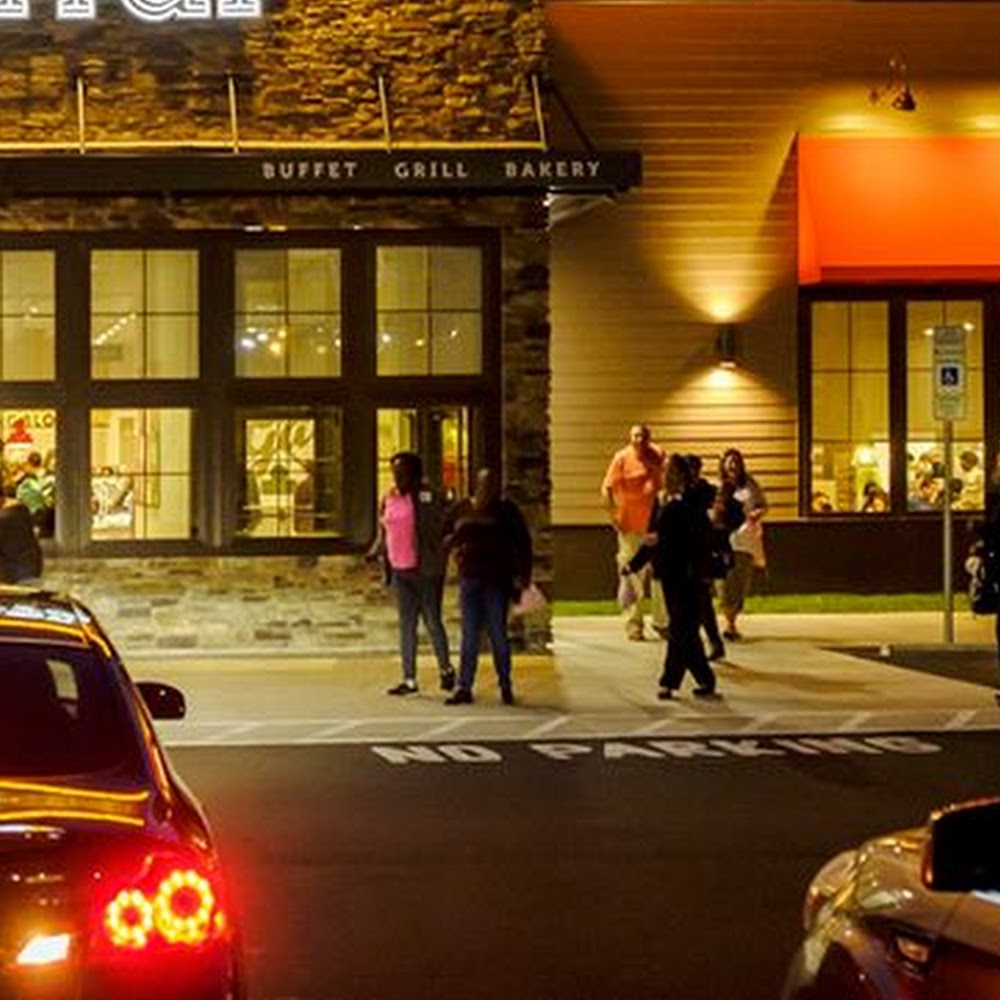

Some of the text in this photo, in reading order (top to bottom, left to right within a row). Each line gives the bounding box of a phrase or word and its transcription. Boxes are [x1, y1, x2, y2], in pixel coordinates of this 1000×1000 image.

[262, 161, 600, 179] BUFFET GRILL BAKERY
[371, 736, 942, 764] NO PARKING
